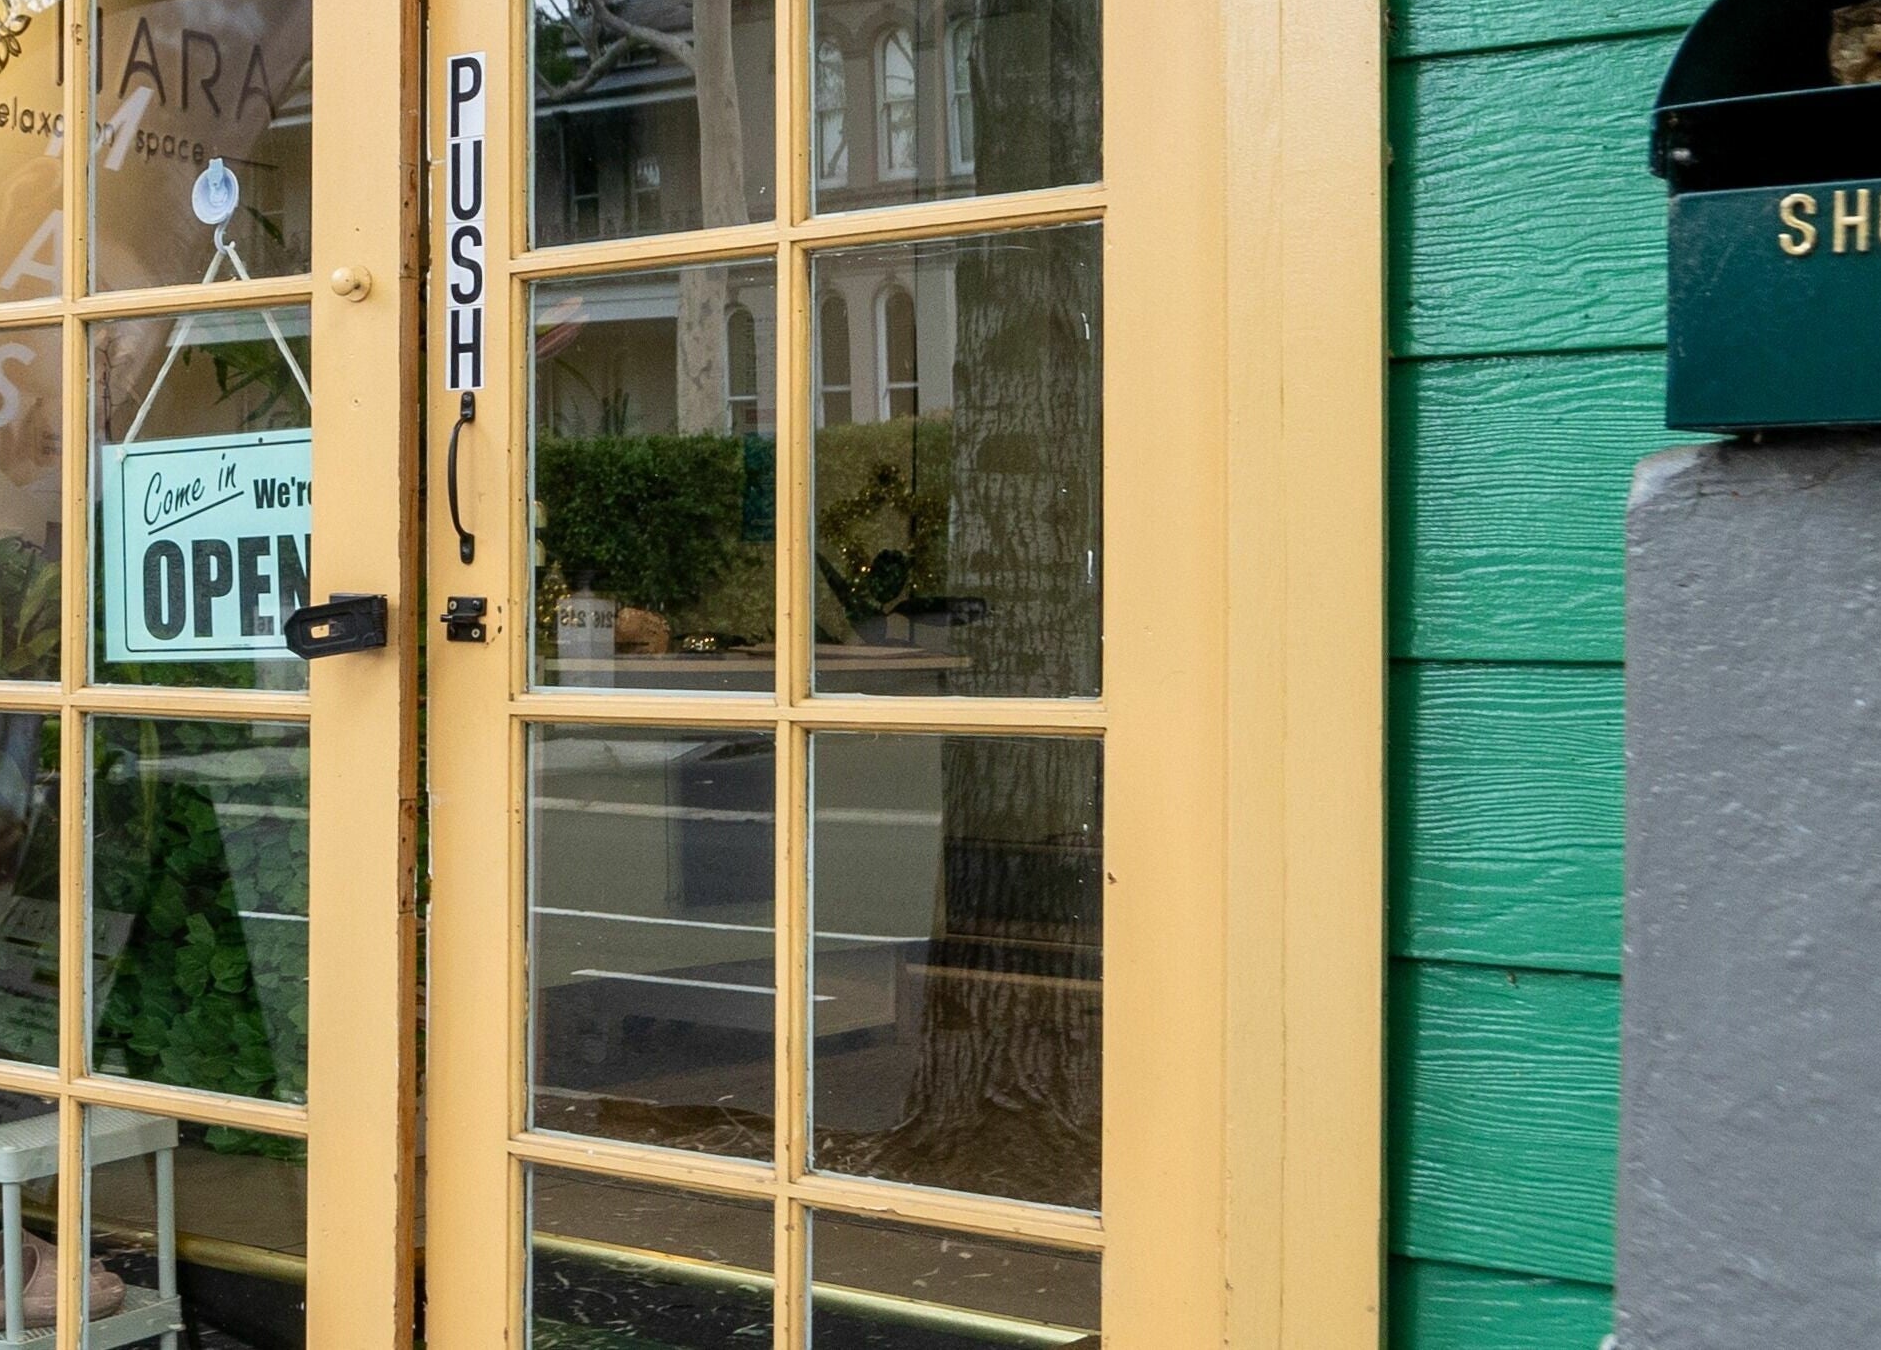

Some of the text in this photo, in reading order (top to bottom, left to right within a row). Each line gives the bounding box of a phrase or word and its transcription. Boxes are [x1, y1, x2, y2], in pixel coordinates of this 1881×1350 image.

[135, 128, 205, 166] space
[450, 56, 483, 389] PUSH
[1778, 188, 1881, 256] SH
[144, 471, 206, 526] Come
[218, 453, 237, 491] in
[143, 533, 312, 641] OPEN
